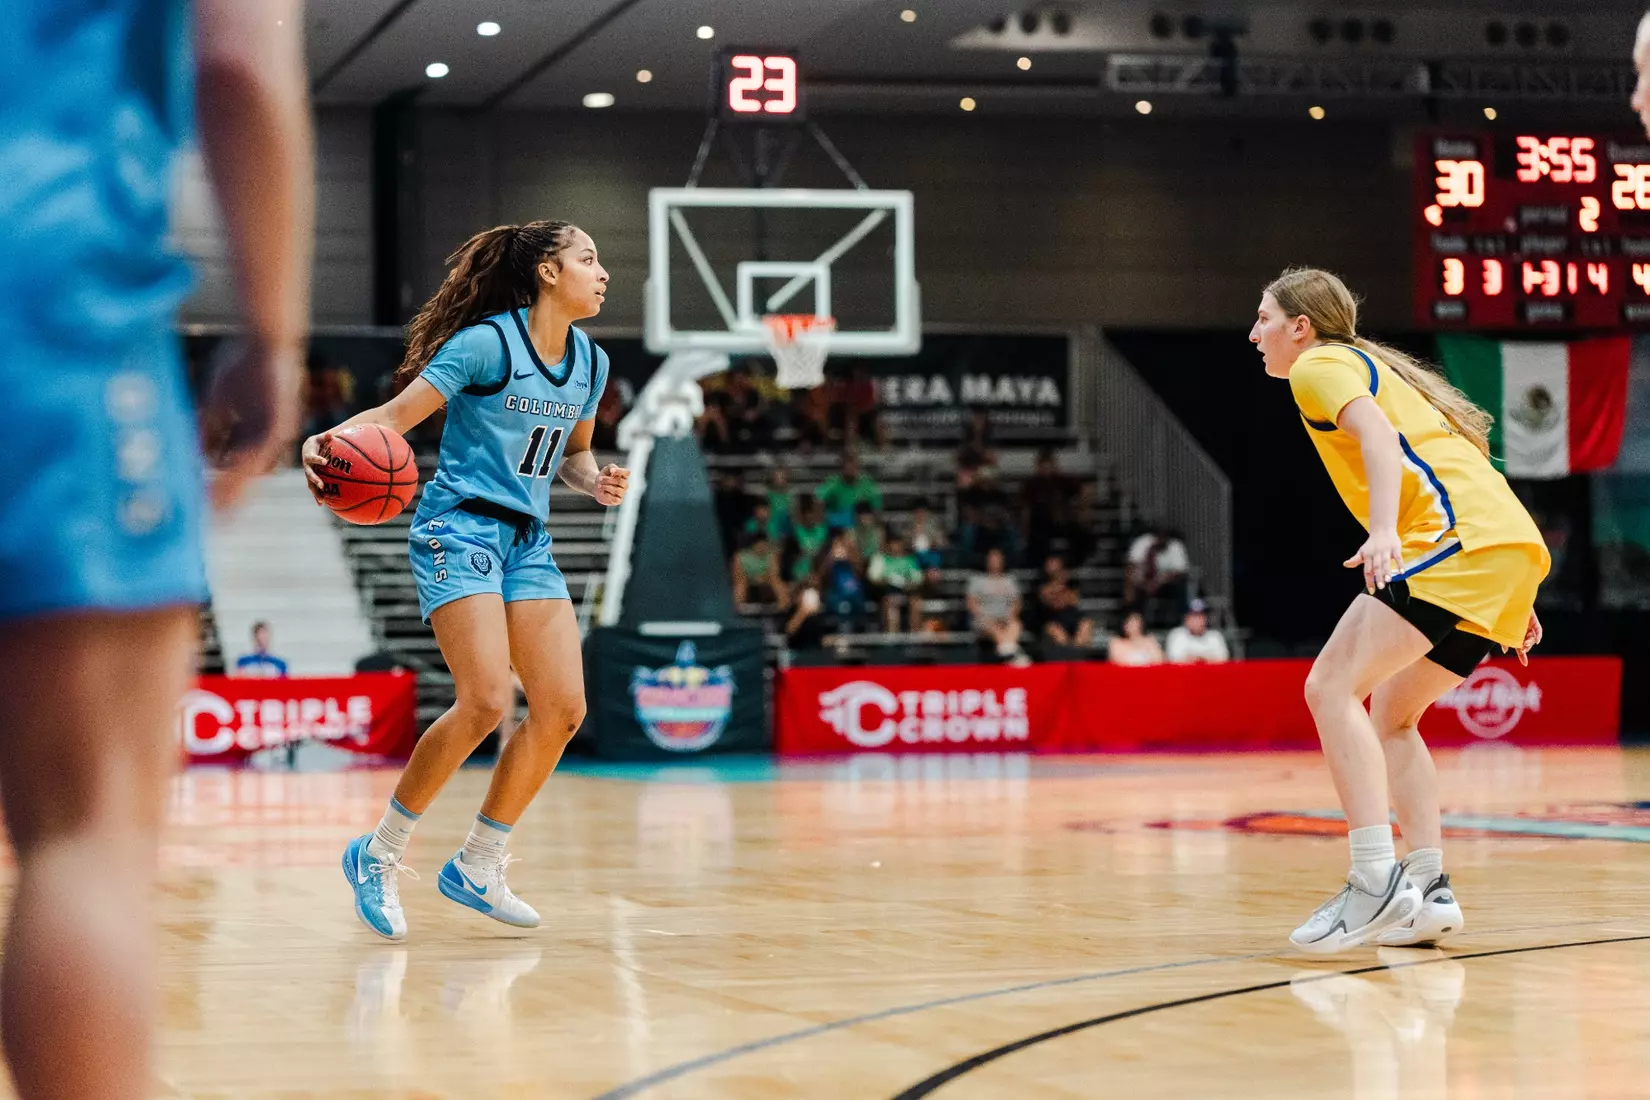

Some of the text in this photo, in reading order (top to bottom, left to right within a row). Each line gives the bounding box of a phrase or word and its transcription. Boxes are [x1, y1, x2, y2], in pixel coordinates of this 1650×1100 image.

[729, 54, 797, 113] 23
[1515, 136, 1597, 183] 3:55
[1434, 159, 1485, 207] 30
[1579, 196, 1601, 232] 2
[1443, 258, 1465, 295] 3
[1482, 259, 1503, 296] 3
[959, 372, 1062, 406] MAYA
[516, 424, 565, 479] 11
[427, 518, 449, 584] LONS
[234, 695, 373, 728] TRIPLE
[899, 687, 1028, 716] TRIPLE
[899, 715, 1030, 744] CROWN
